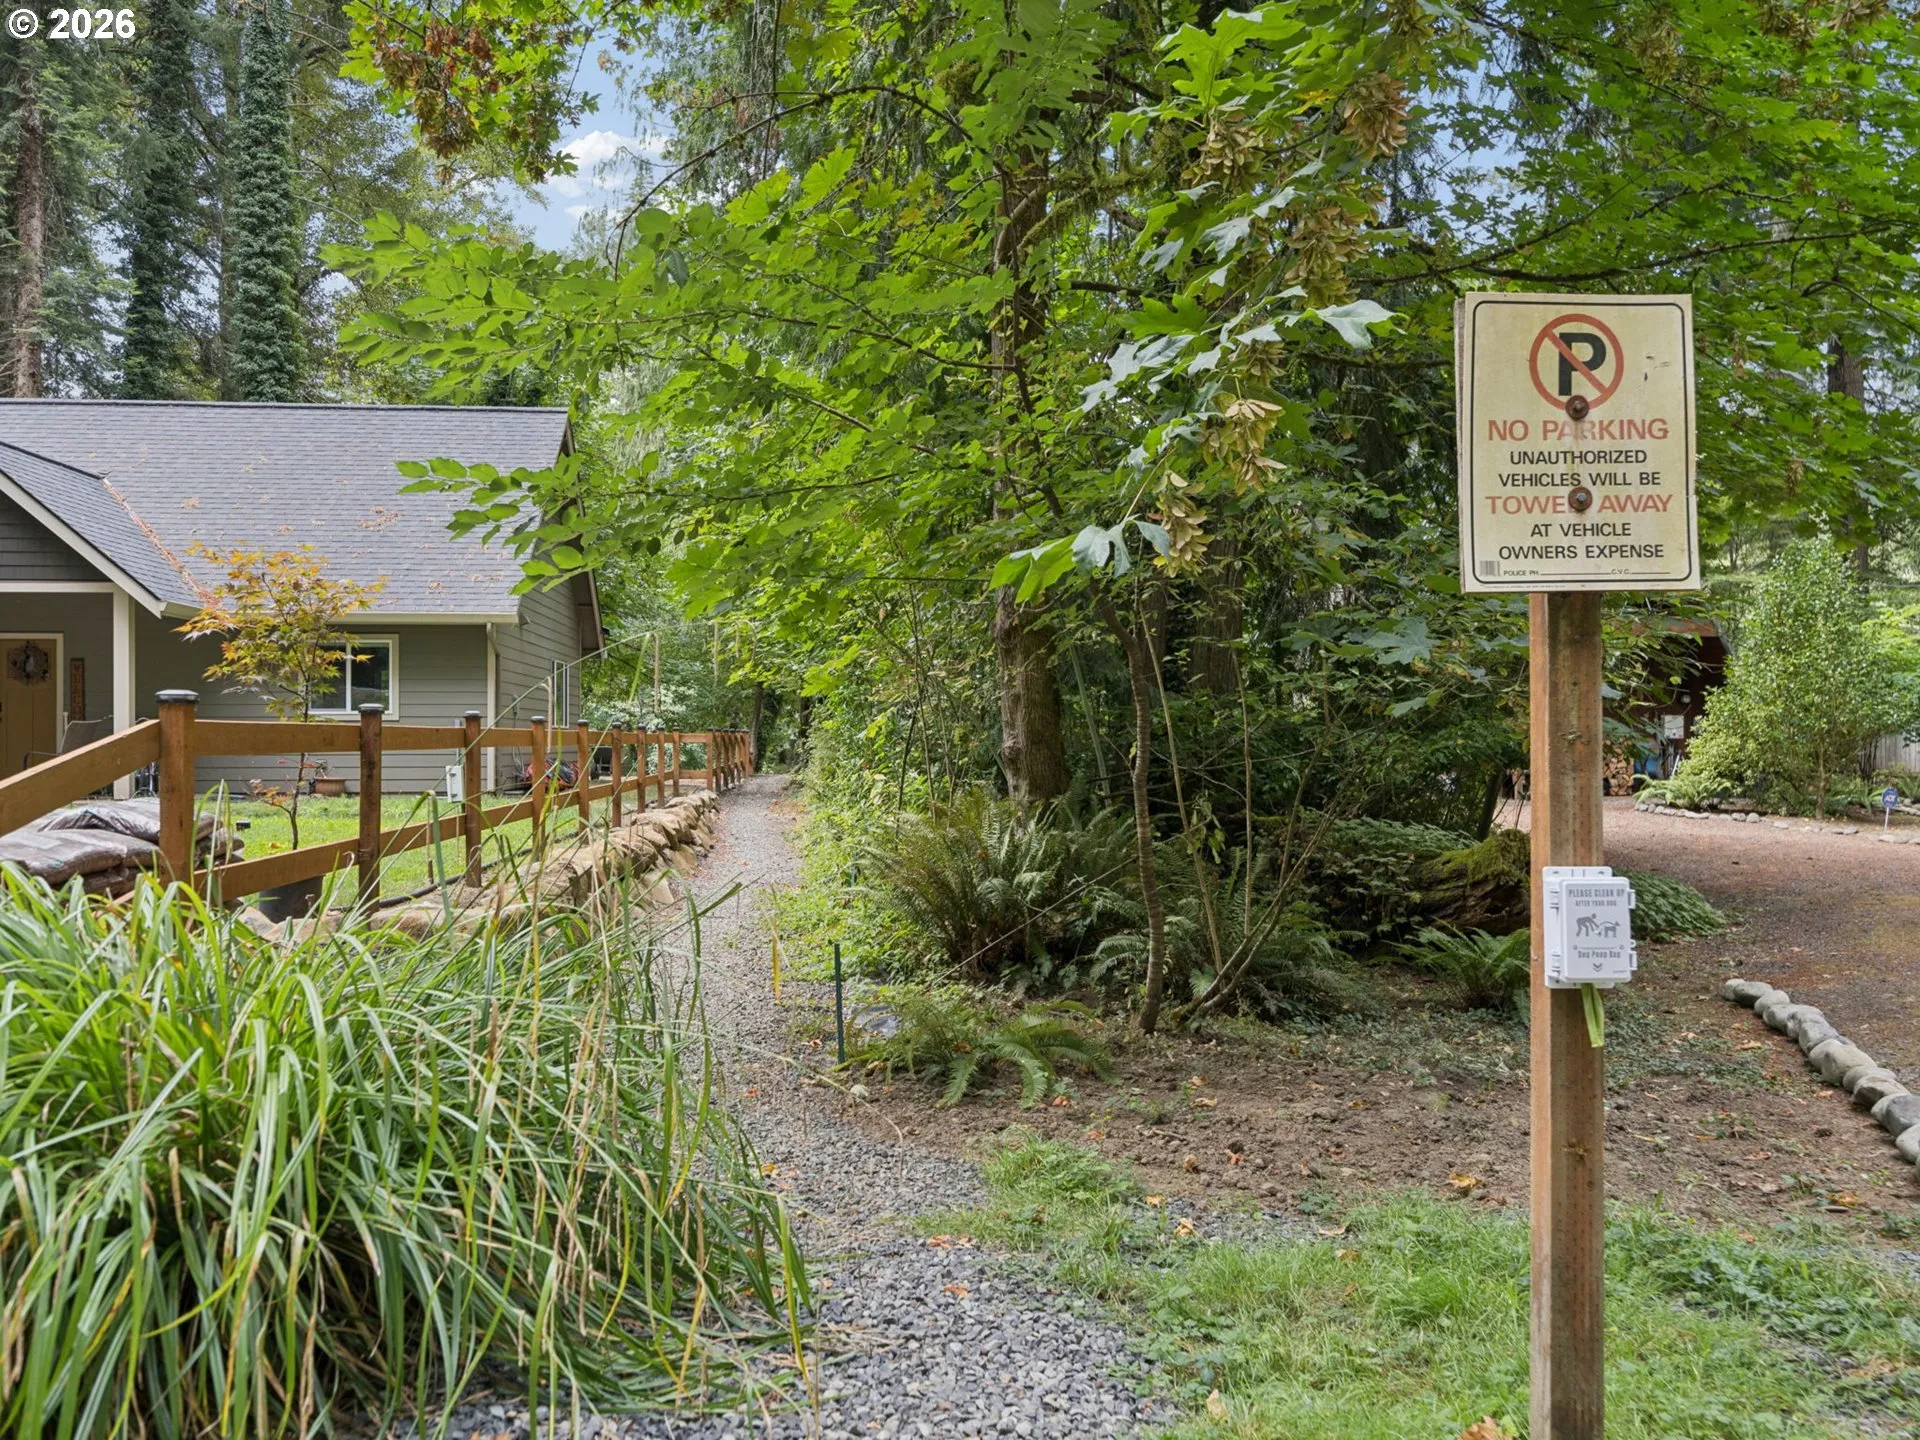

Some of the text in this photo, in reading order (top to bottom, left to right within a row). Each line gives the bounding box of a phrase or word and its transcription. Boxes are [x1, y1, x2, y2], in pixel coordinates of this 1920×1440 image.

[1558, 332, 1607, 397] P
[1488, 418, 1669, 441] NO PARKING
[1510, 450, 1647, 465] UNAUTHORIZED
[1498, 472, 1661, 487] VEHICLES WILL BE
[1485, 494, 1673, 515] TOWE AWAY
[1530, 523, 1632, 537] AT VEHICLE
[1499, 544, 1664, 560] OWNERS EXPENSE
[1568, 888, 1592, 897] PLEASE
[1594, 888, 1614, 897] CLEAN
